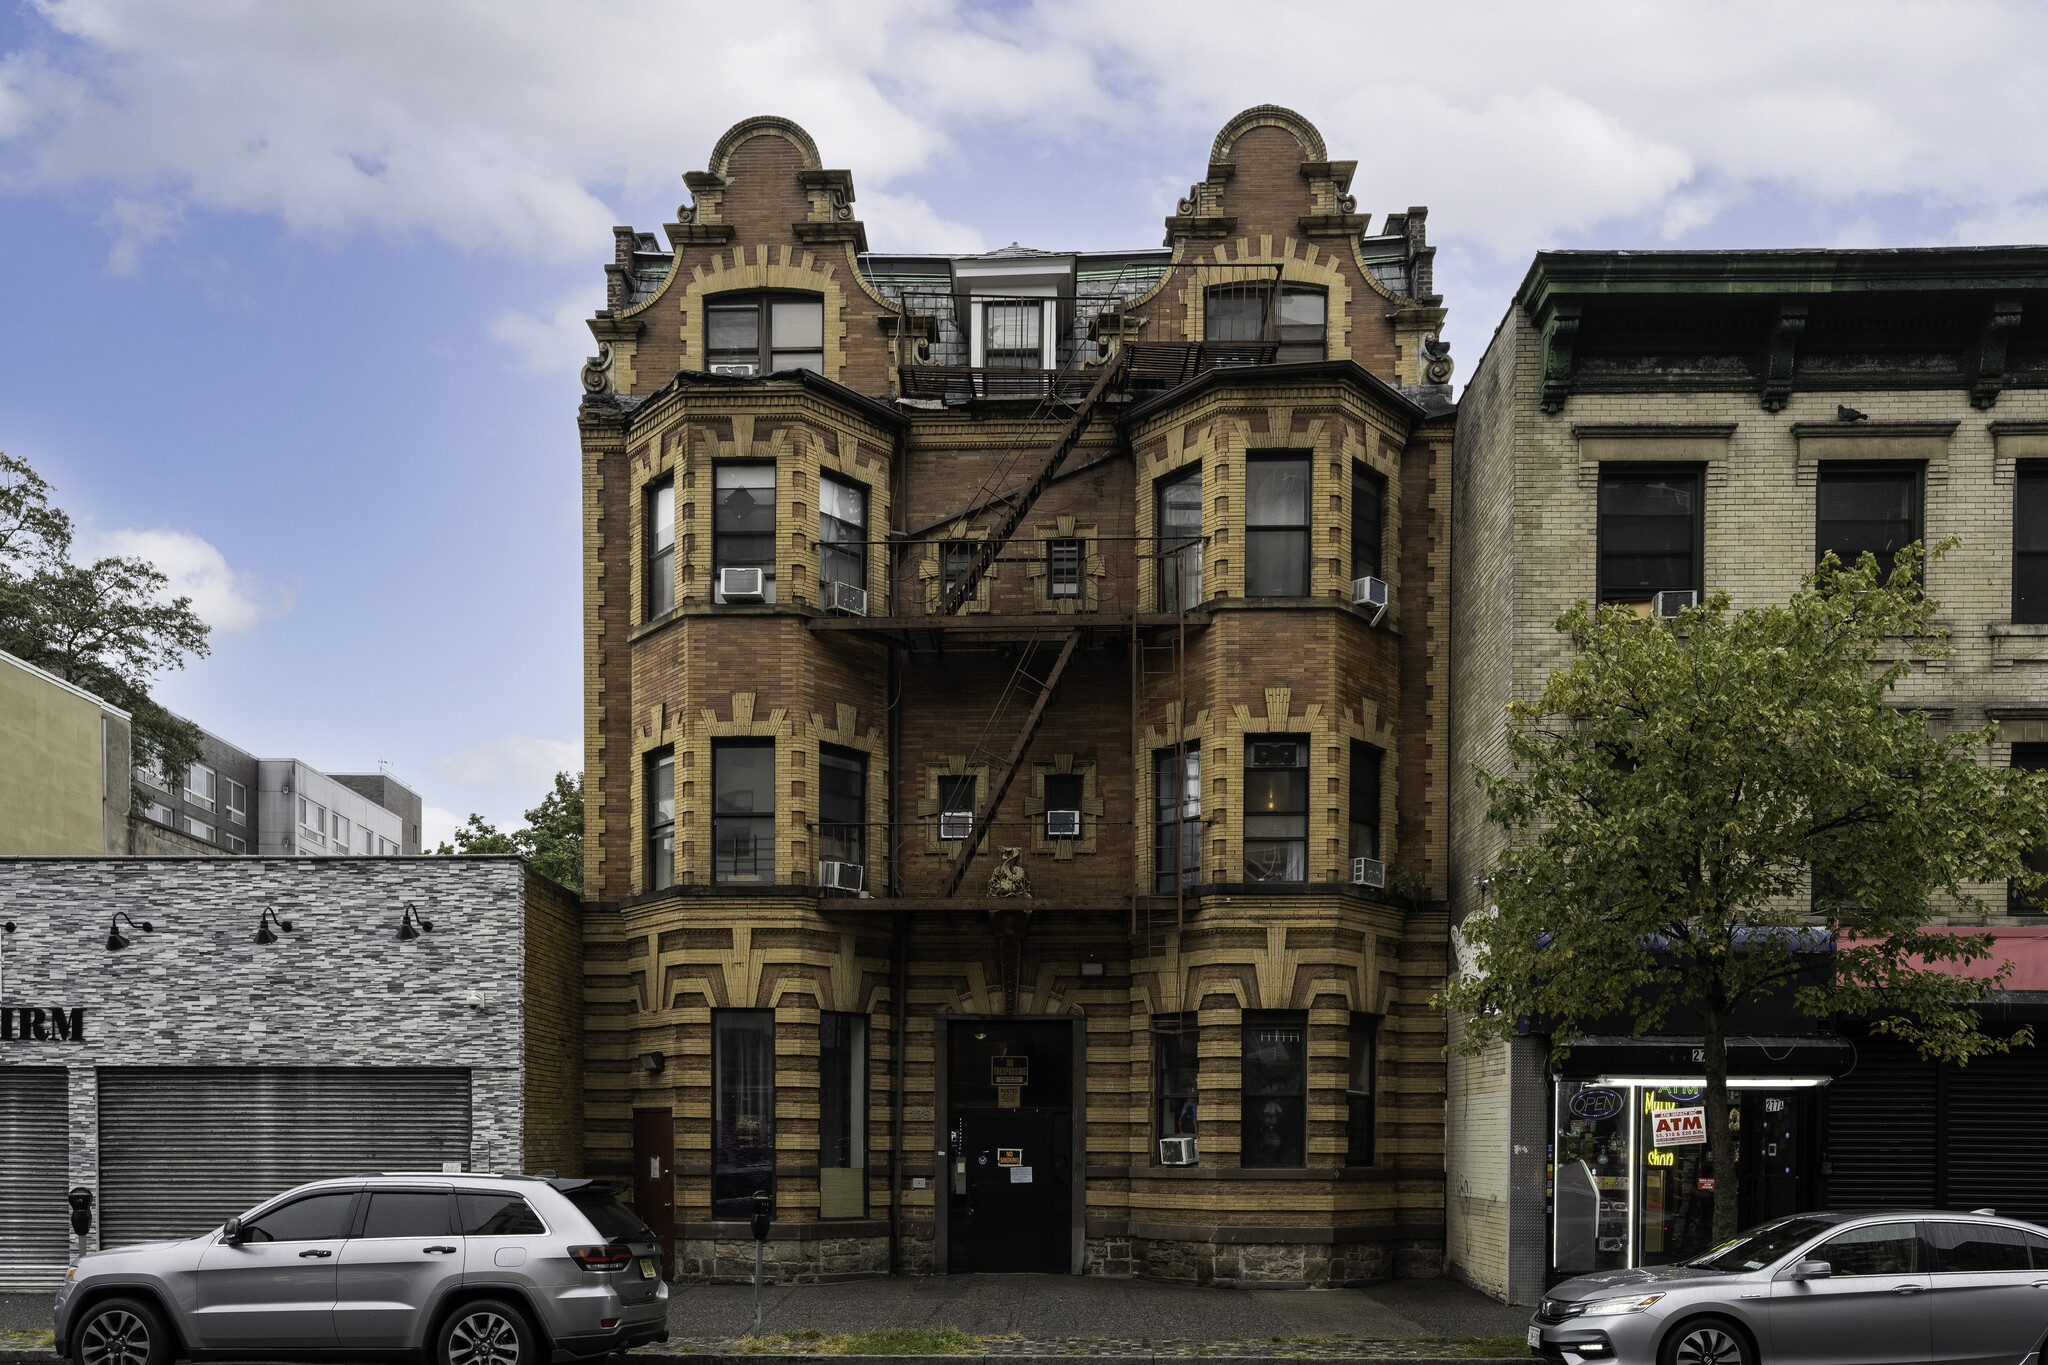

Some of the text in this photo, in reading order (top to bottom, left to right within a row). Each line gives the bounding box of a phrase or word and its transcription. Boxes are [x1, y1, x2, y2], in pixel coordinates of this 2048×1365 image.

[1574, 1095, 1616, 1113] OPEN
[1766, 1100, 1784, 1111] 277A
[910, 1107, 931, 1120] 279
[1656, 1116, 1702, 1132] ATM
